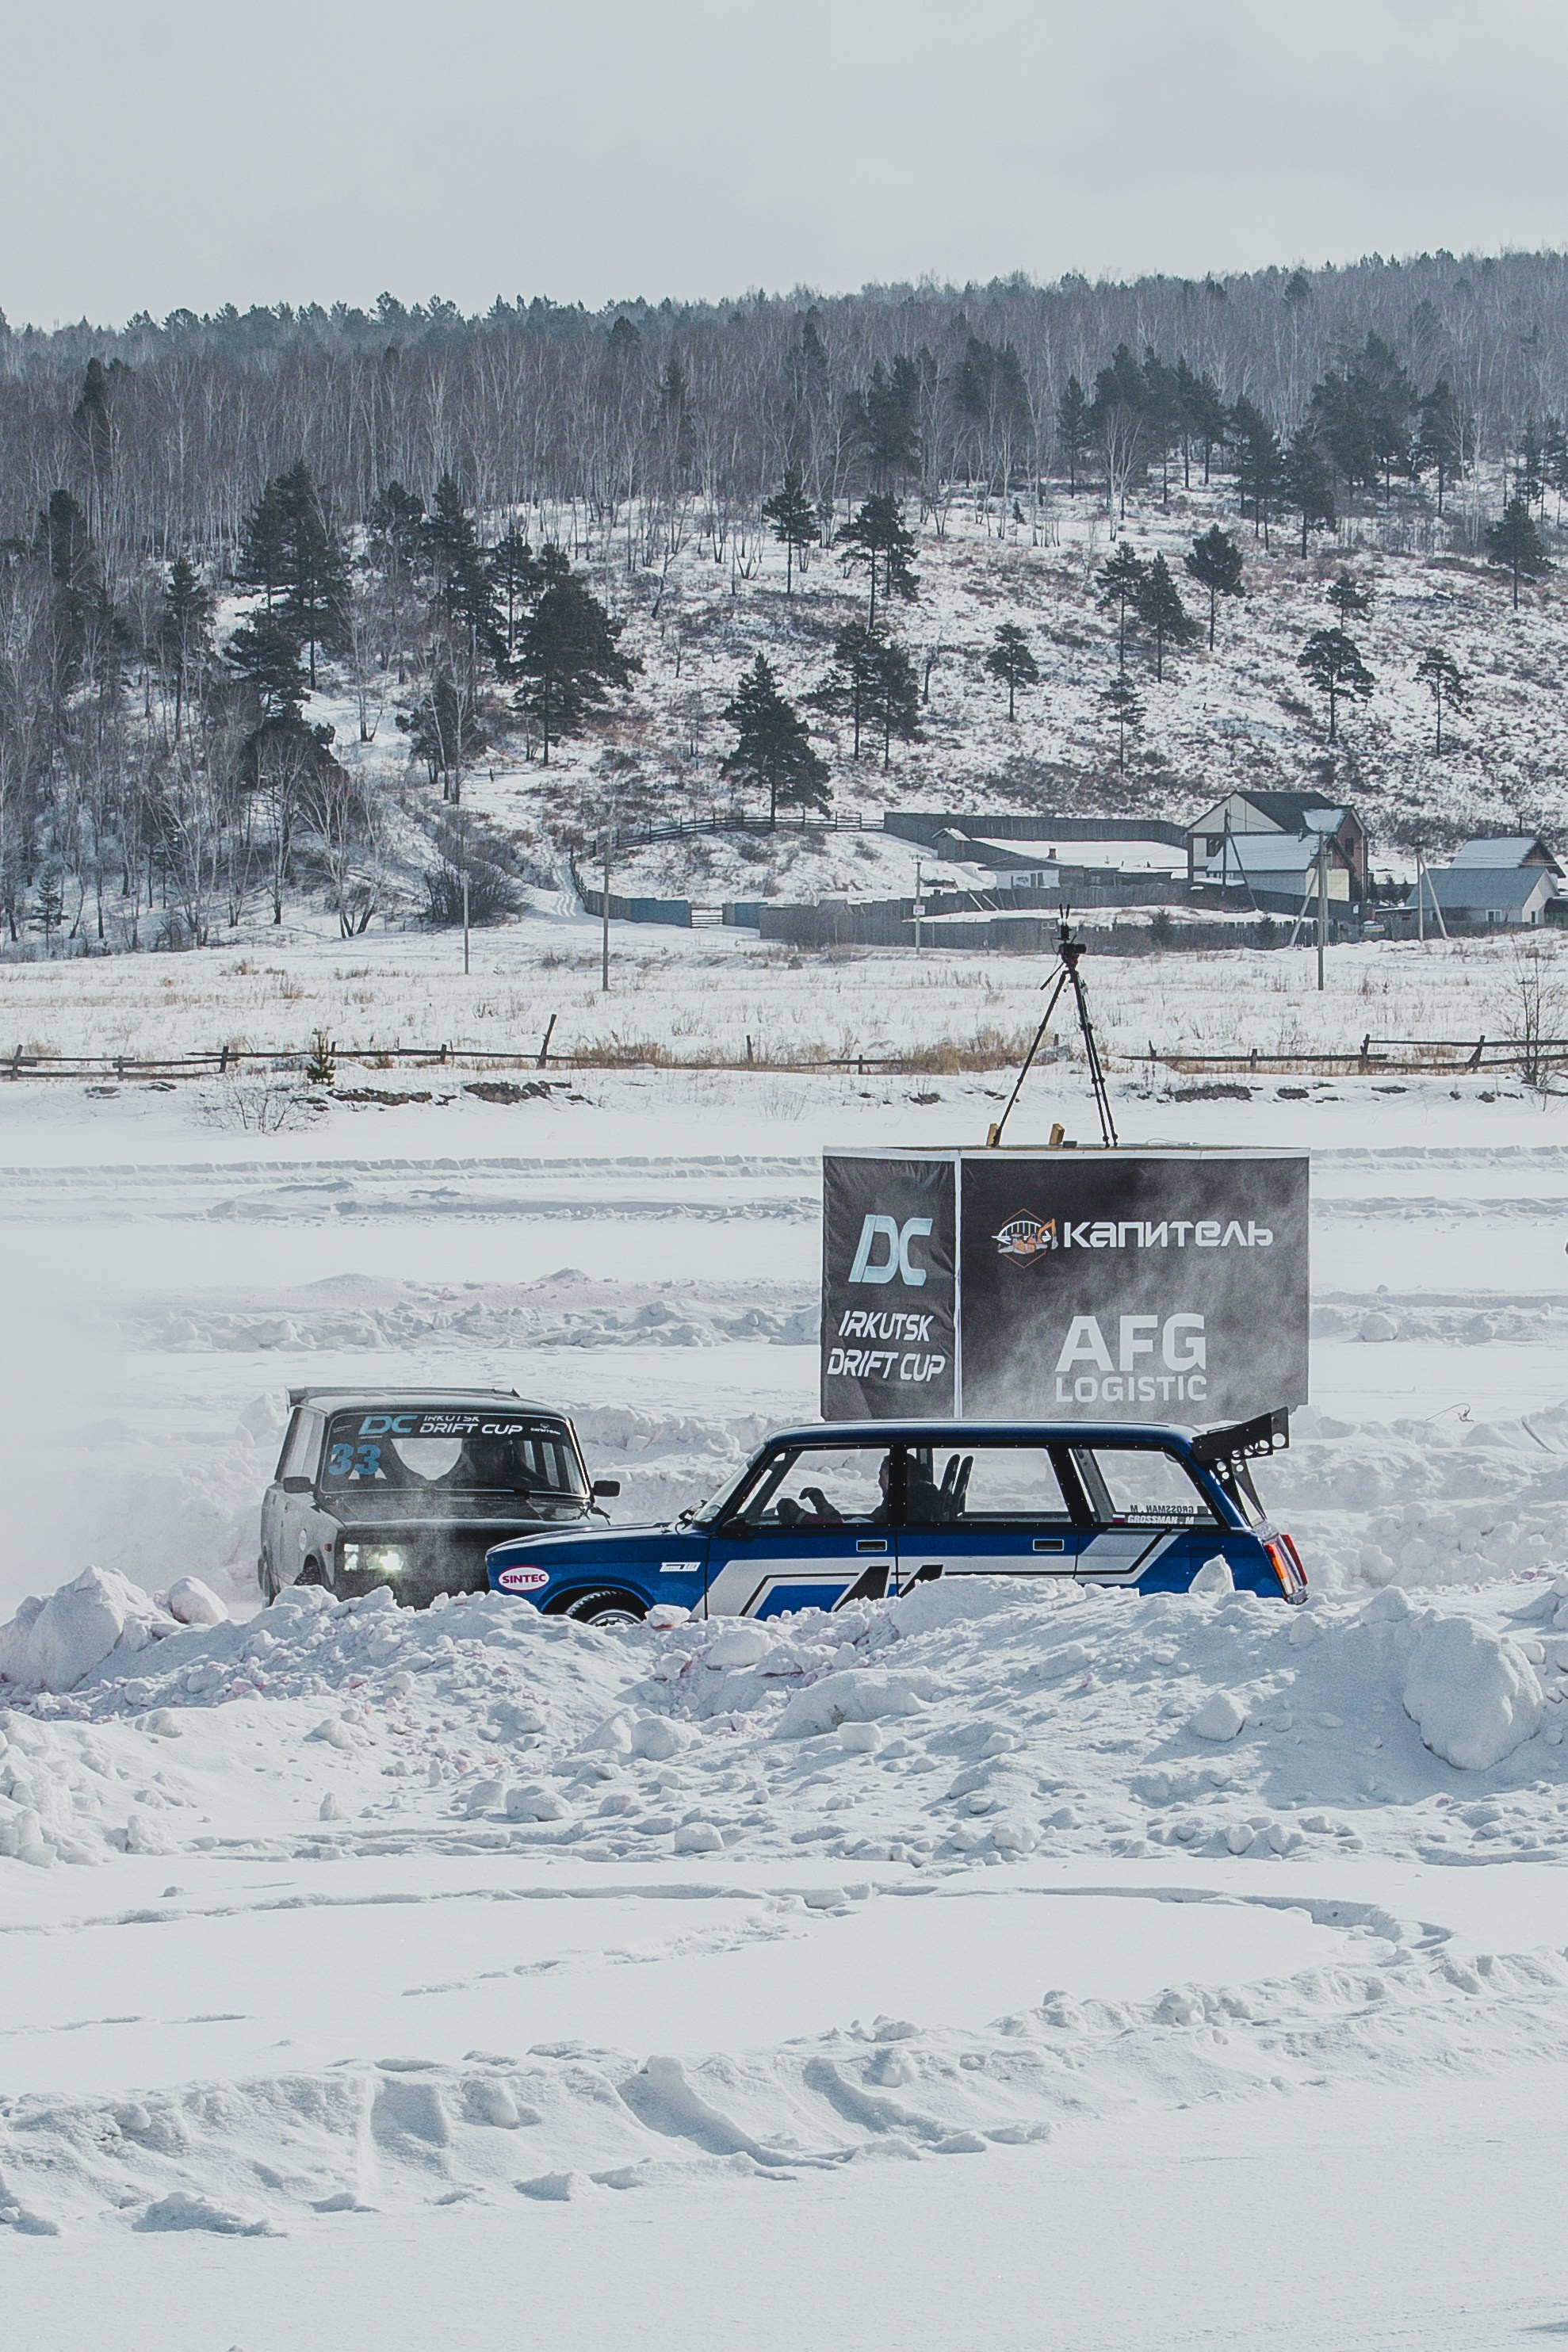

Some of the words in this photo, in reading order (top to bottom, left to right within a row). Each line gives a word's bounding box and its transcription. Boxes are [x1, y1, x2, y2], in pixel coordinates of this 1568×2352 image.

[848, 1214, 933, 1286] DC
[838, 1310, 934, 1341] IRKUTSK
[1054, 1313, 1207, 1372] AFG
[827, 1348, 899, 1379] DRIFT
[900, 1353, 946, 1382] CUP
[1056, 1375, 1207, 1403] LOGISTIC
[358, 1415, 418, 1435] DC
[419, 1422, 479, 1434] DRIFT
[481, 1424, 523, 1435] CUP
[328, 1443, 381, 1476] 33
[1127, 1515, 1178, 1524] GROSSMAN
[502, 1574, 546, 1584] SINTEC
